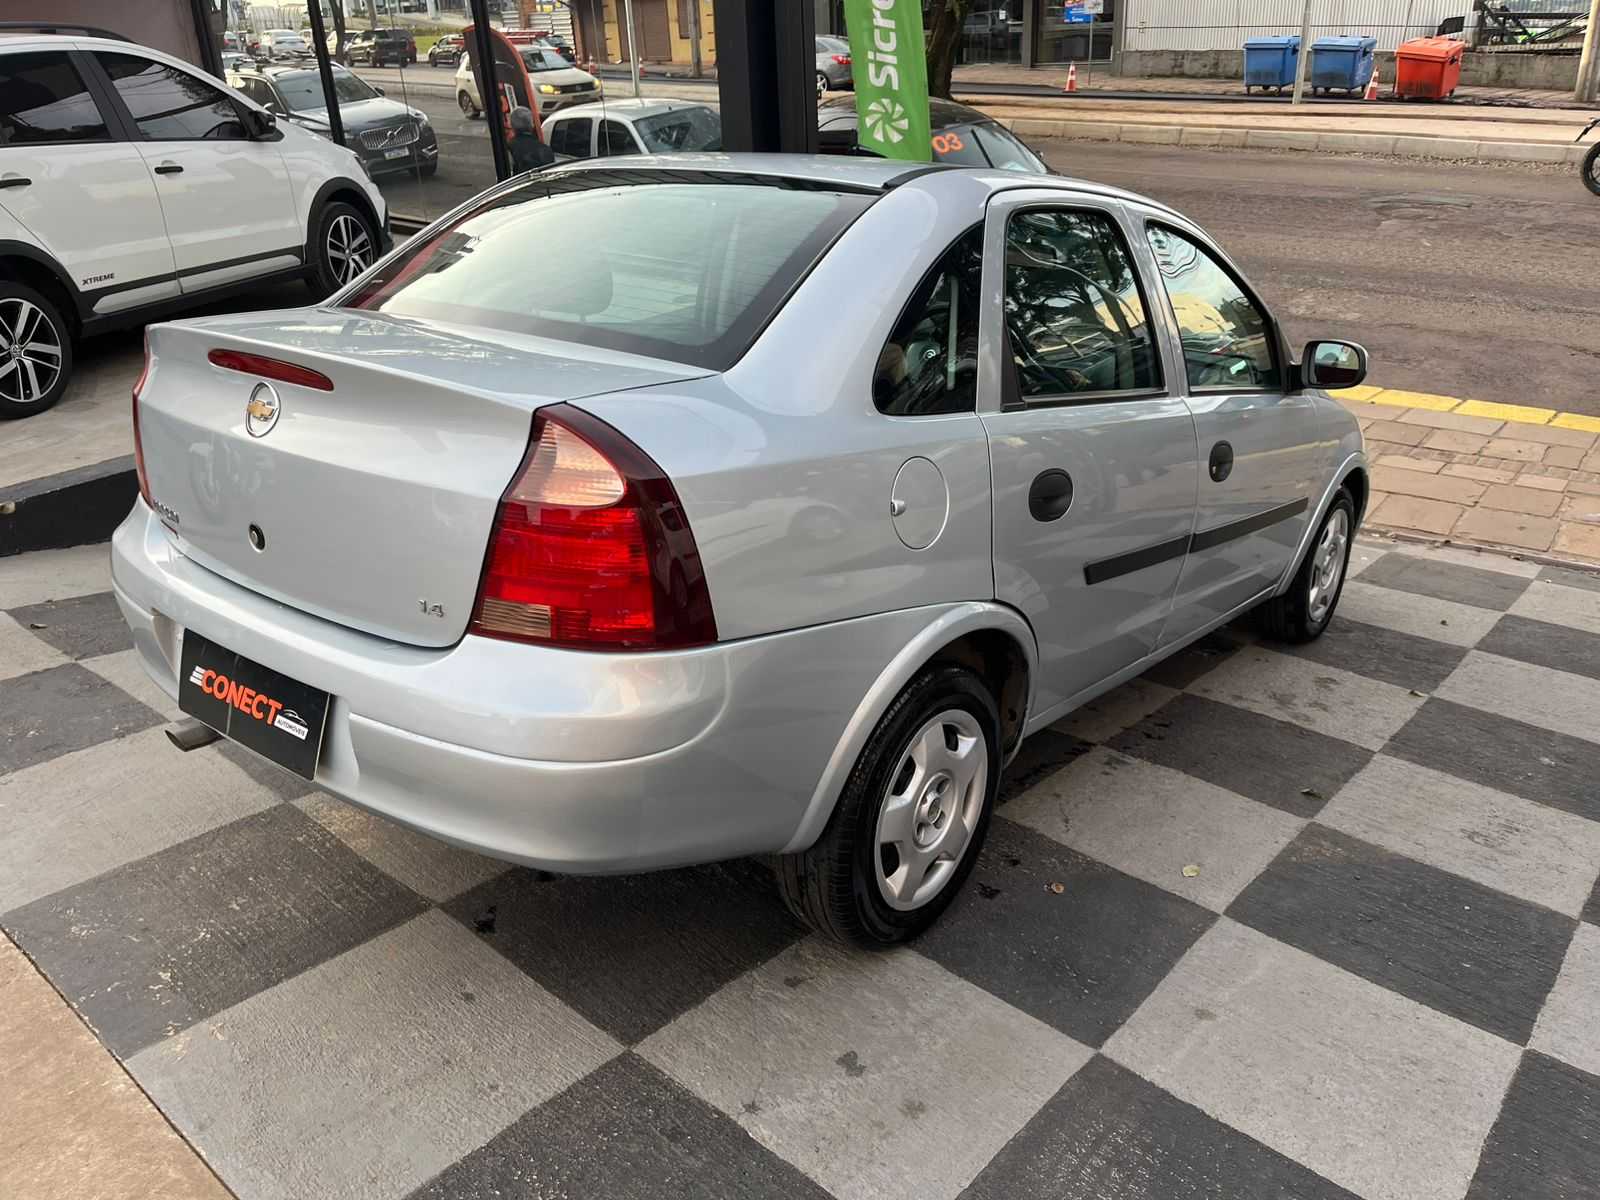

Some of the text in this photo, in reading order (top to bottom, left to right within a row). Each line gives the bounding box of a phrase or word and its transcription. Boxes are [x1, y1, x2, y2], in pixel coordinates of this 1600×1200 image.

[931, 132, 964, 154] 03
[82, 272, 115, 286] XTREME
[202, 669, 282, 725] CONECT
